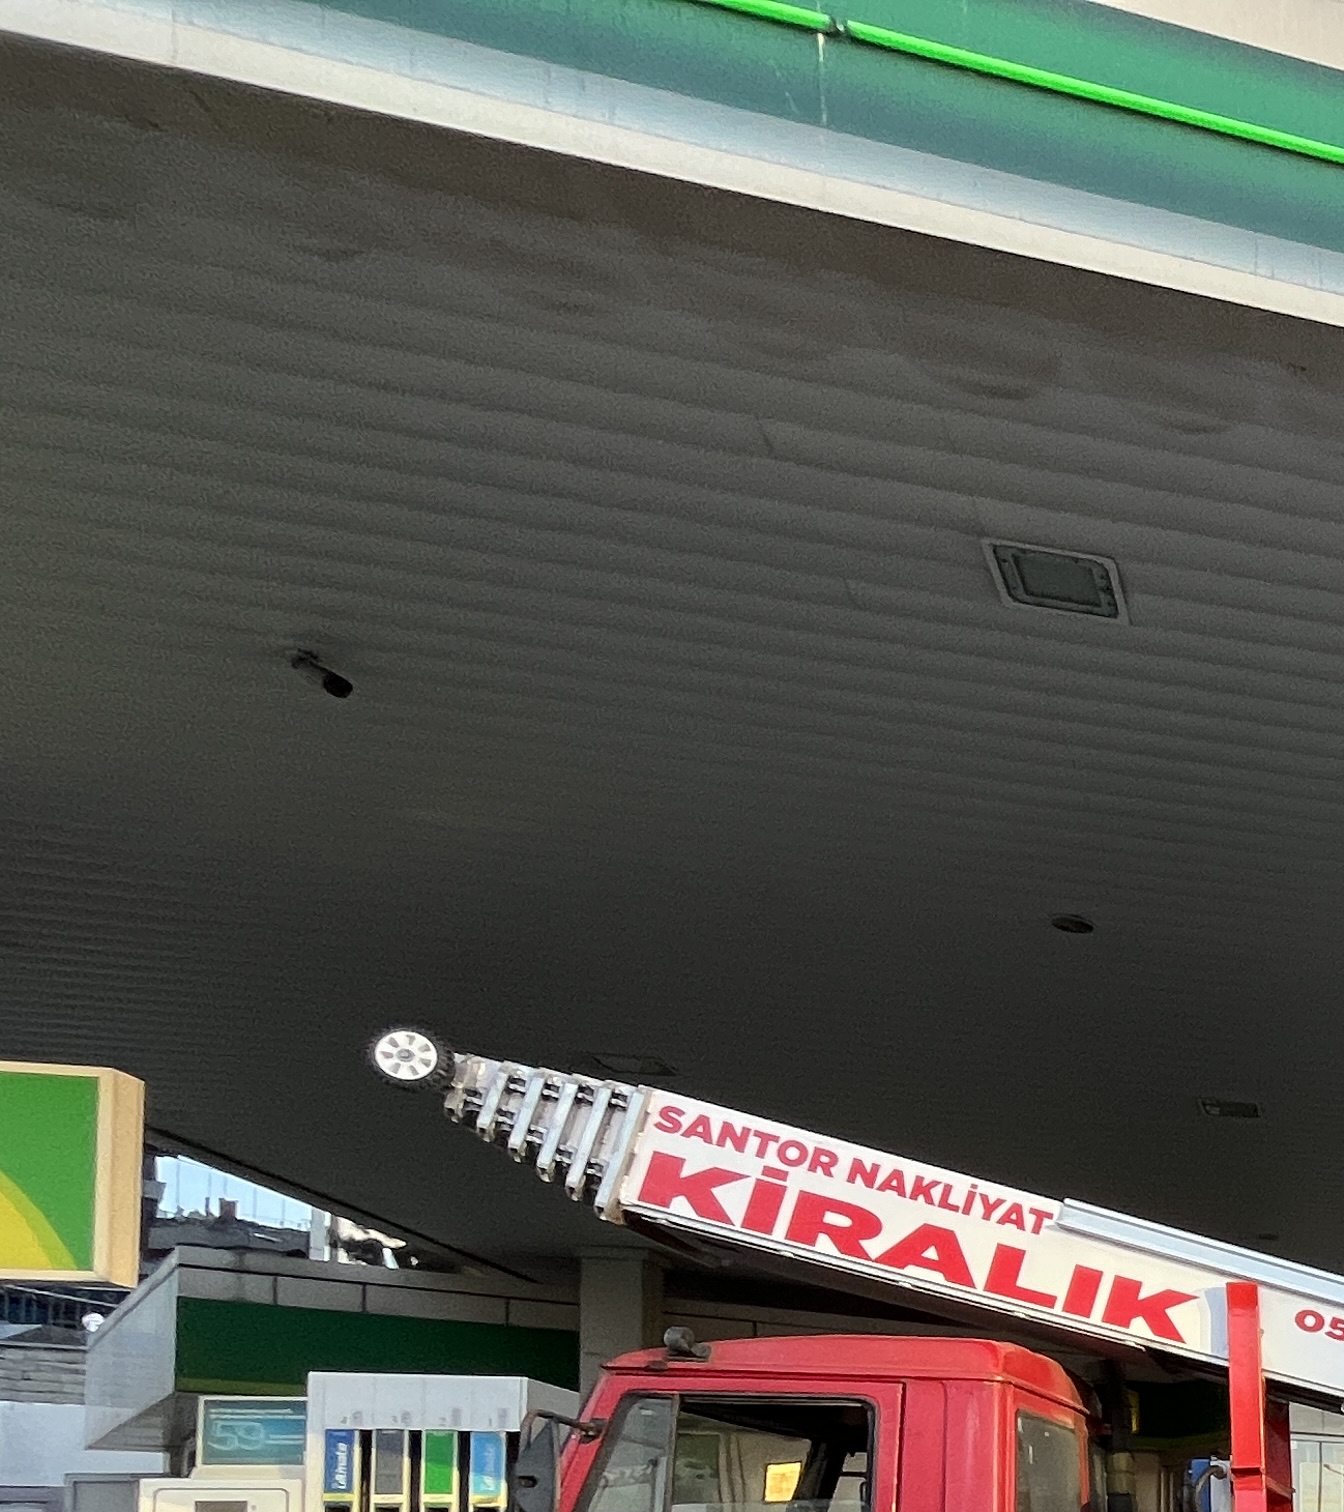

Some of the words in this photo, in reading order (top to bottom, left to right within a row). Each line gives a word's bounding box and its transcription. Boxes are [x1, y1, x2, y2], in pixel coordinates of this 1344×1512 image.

[637, 1152, 1200, 1344] KİRALIK
[654, 1104, 839, 1177] SANTOR
[848, 1157, 1054, 1235] NAKLİYAT
